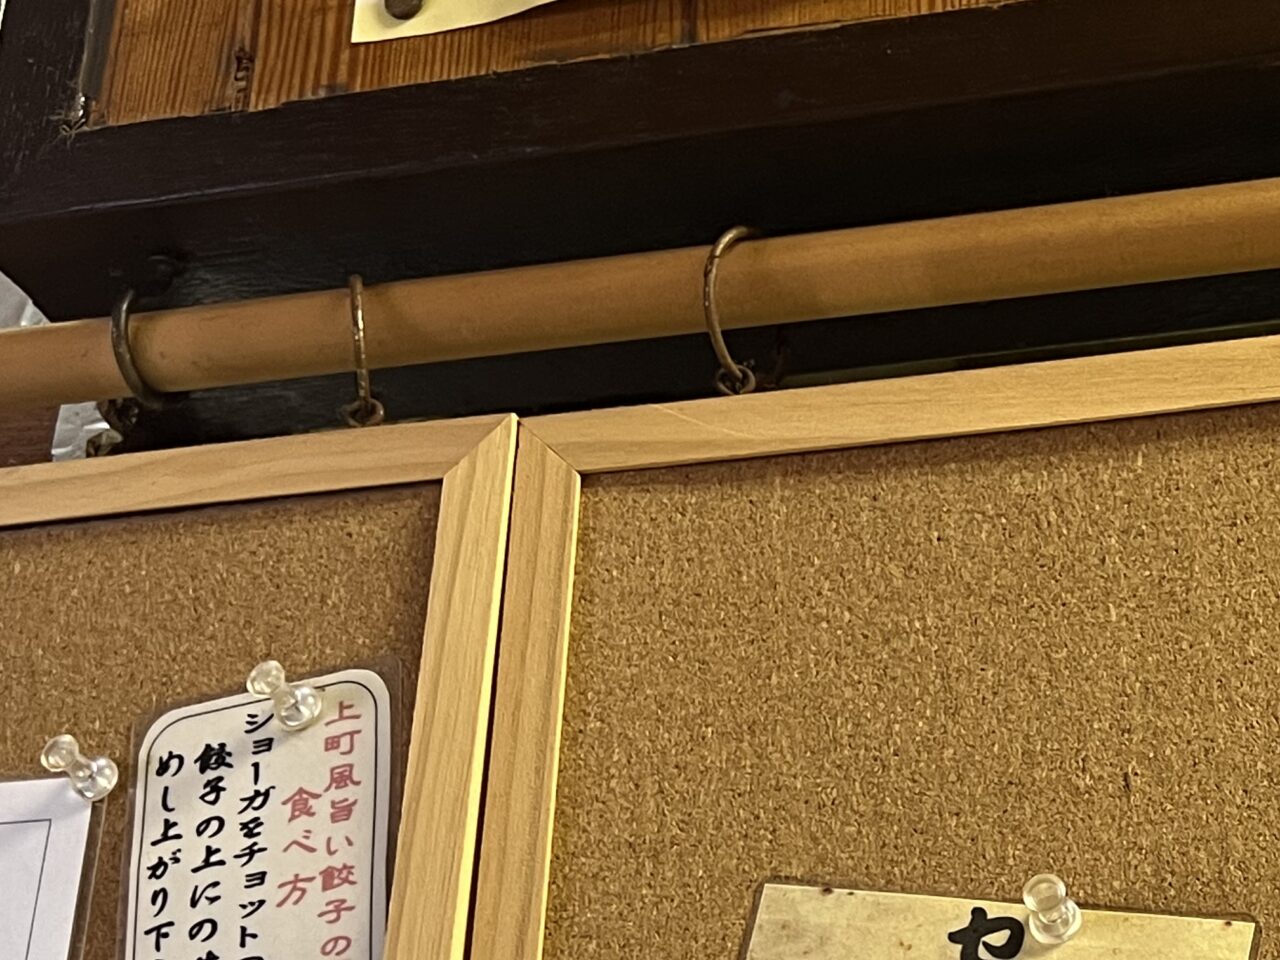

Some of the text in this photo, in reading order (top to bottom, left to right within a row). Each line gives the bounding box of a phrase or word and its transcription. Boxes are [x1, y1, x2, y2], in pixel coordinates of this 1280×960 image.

[275, 786, 323, 909] 食べ方
[316, 702, 362, 958] 上町風旨い餃子の
